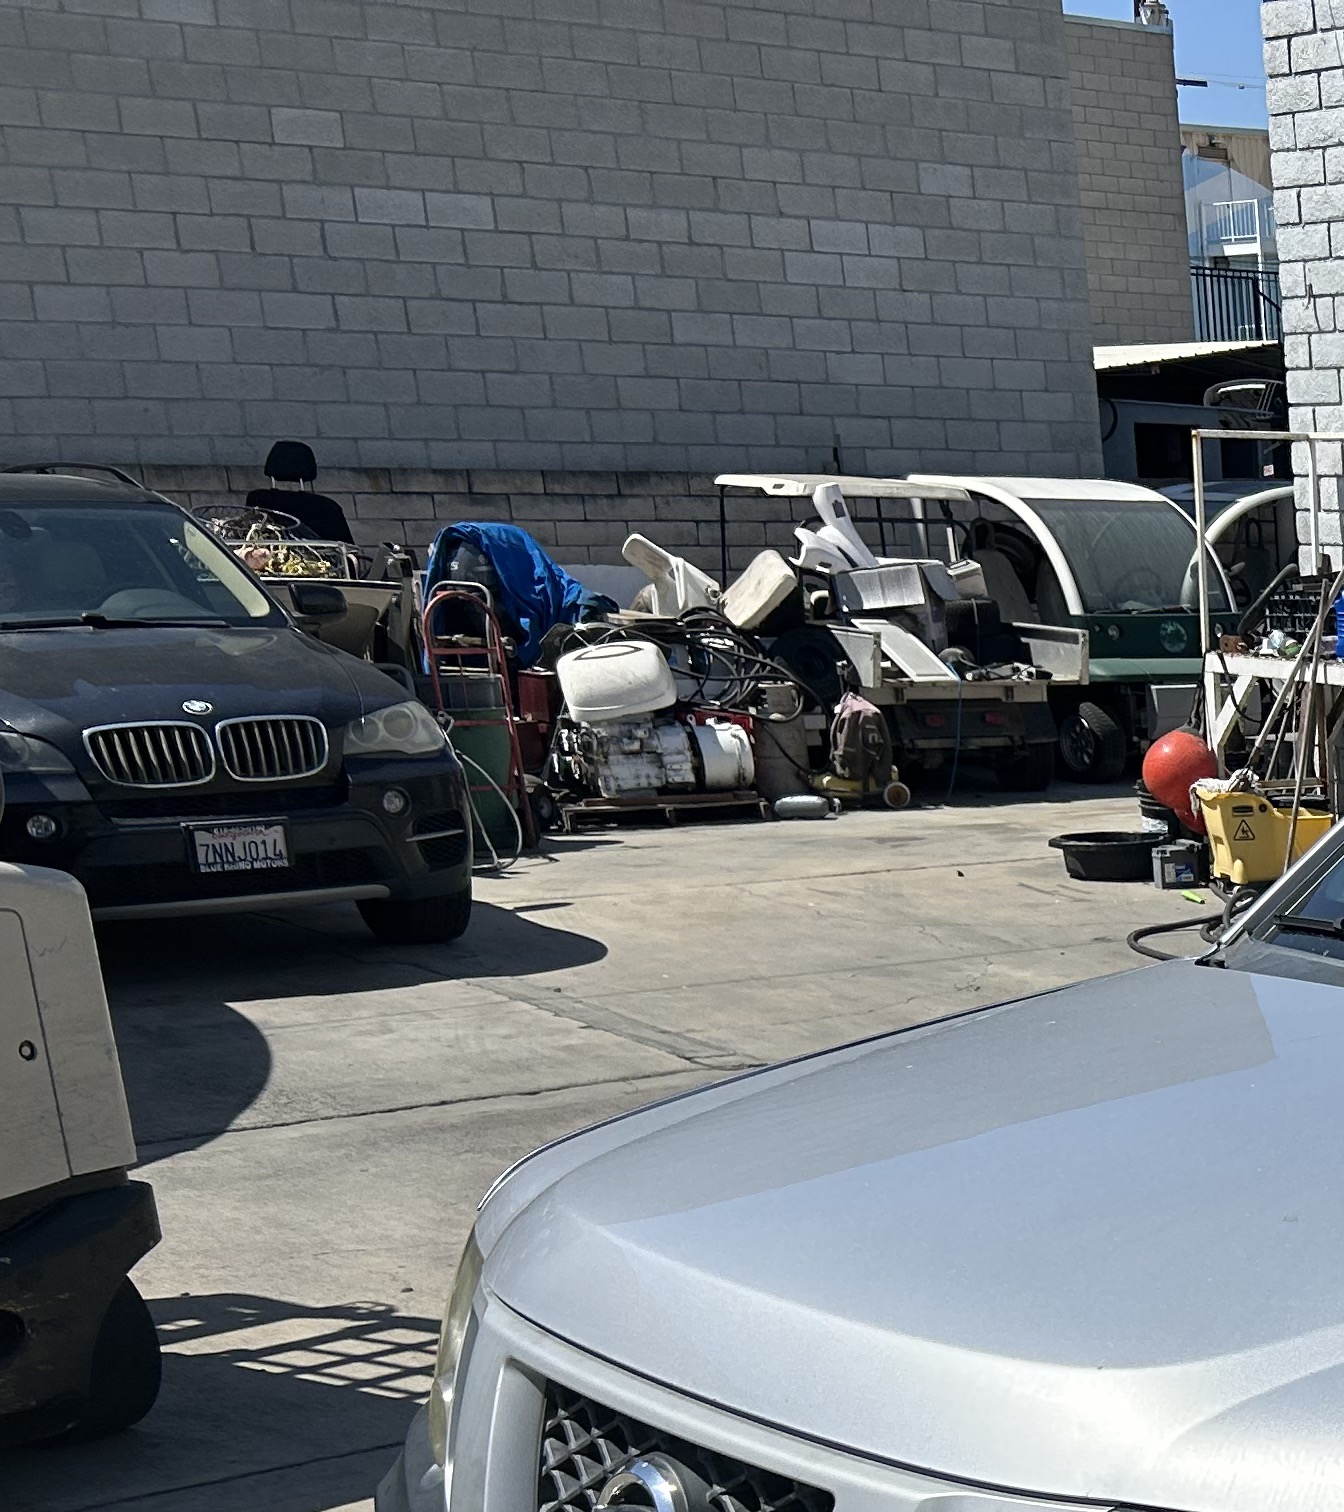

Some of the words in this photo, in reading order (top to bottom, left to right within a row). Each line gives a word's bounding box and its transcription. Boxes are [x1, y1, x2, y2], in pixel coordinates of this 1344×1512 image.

[199, 838, 285, 865] 7NNJ014
[200, 862, 223, 873] BLUE
[223, 860, 252, 871] RHINO
[252, 857, 289, 869] MOTORS
